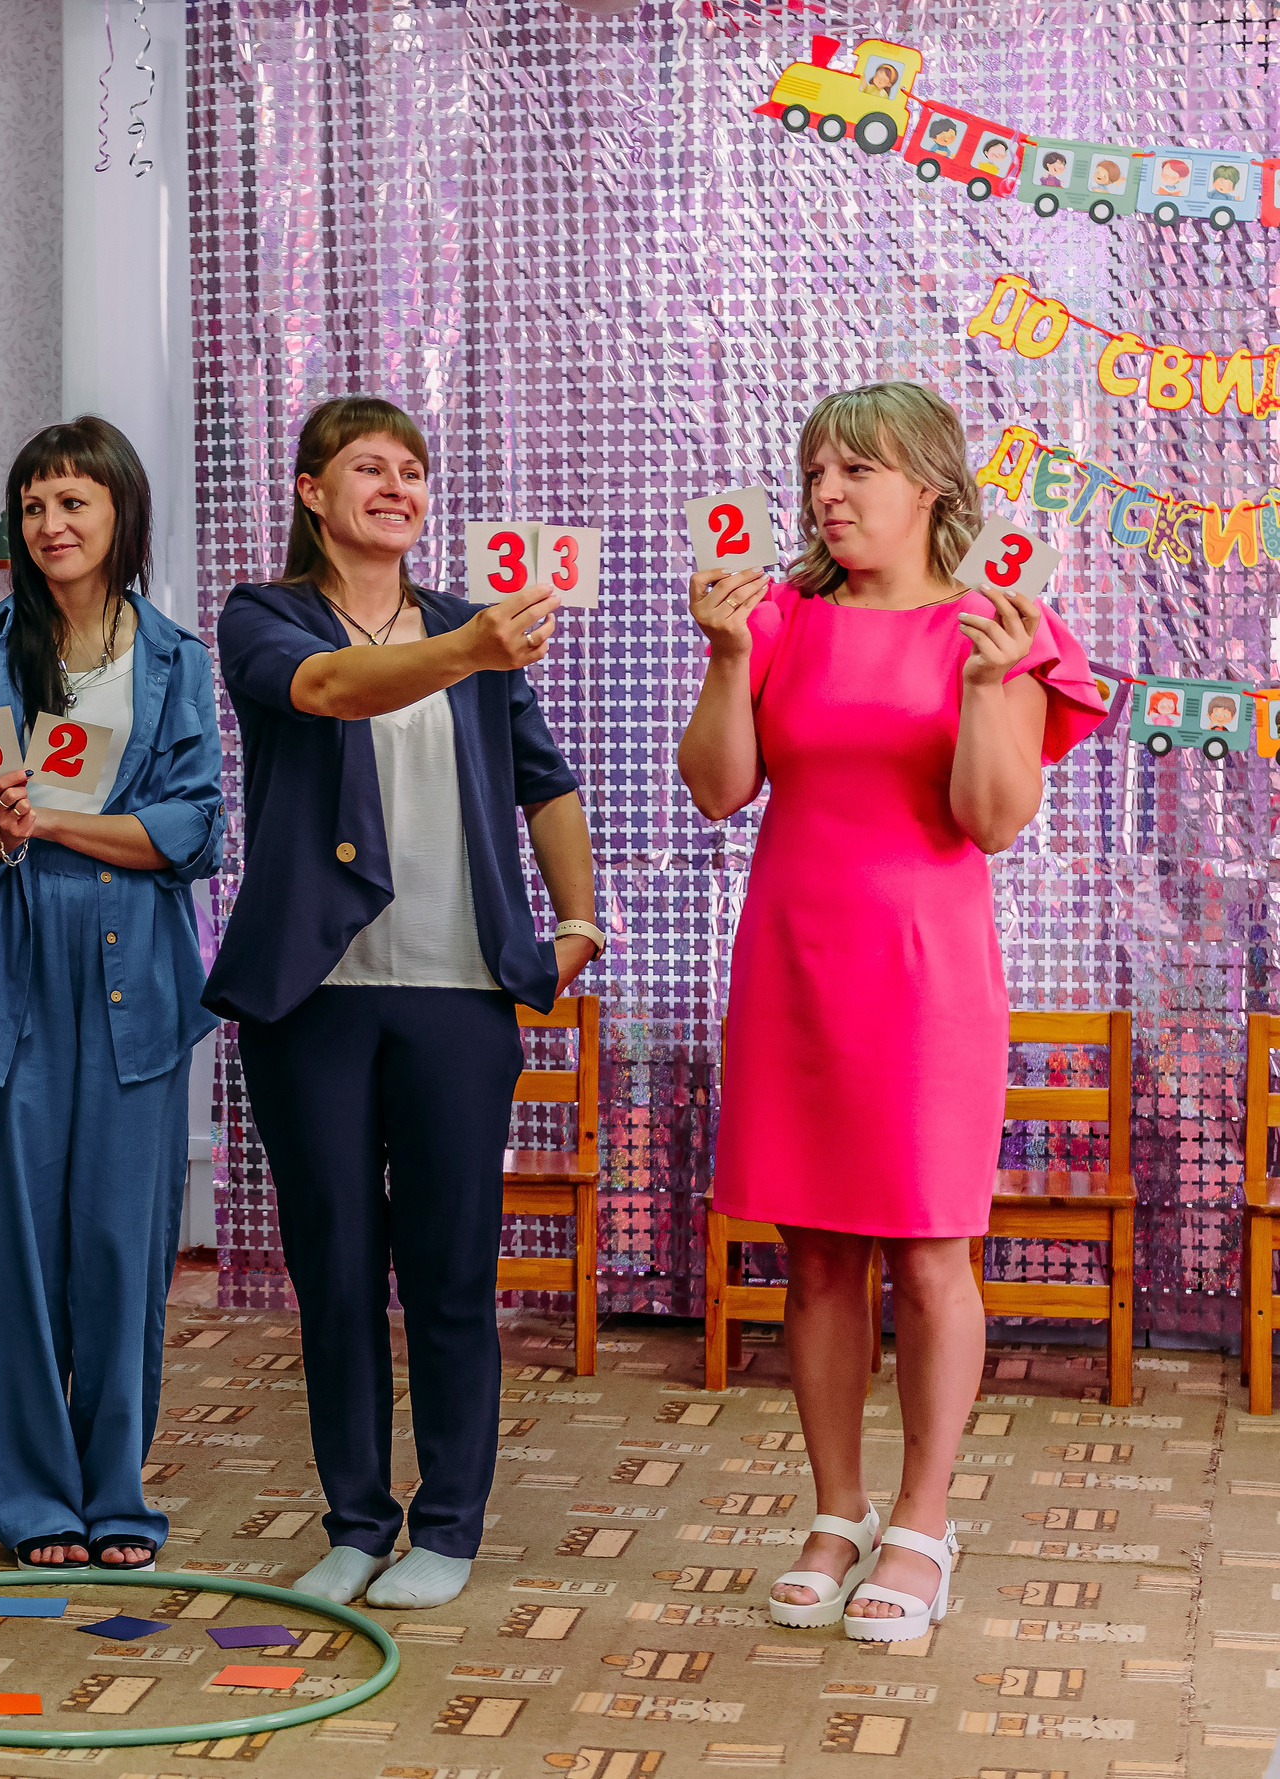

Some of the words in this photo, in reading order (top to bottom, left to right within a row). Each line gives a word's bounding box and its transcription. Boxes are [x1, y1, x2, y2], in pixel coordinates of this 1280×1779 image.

[967, 274, 1070, 359] ДО
[708, 503, 750, 558] 2
[487, 531, 528, 593] 3
[551, 535, 579, 591] 3
[984, 533, 1033, 587] 3
[41, 723, 88, 777] 2
